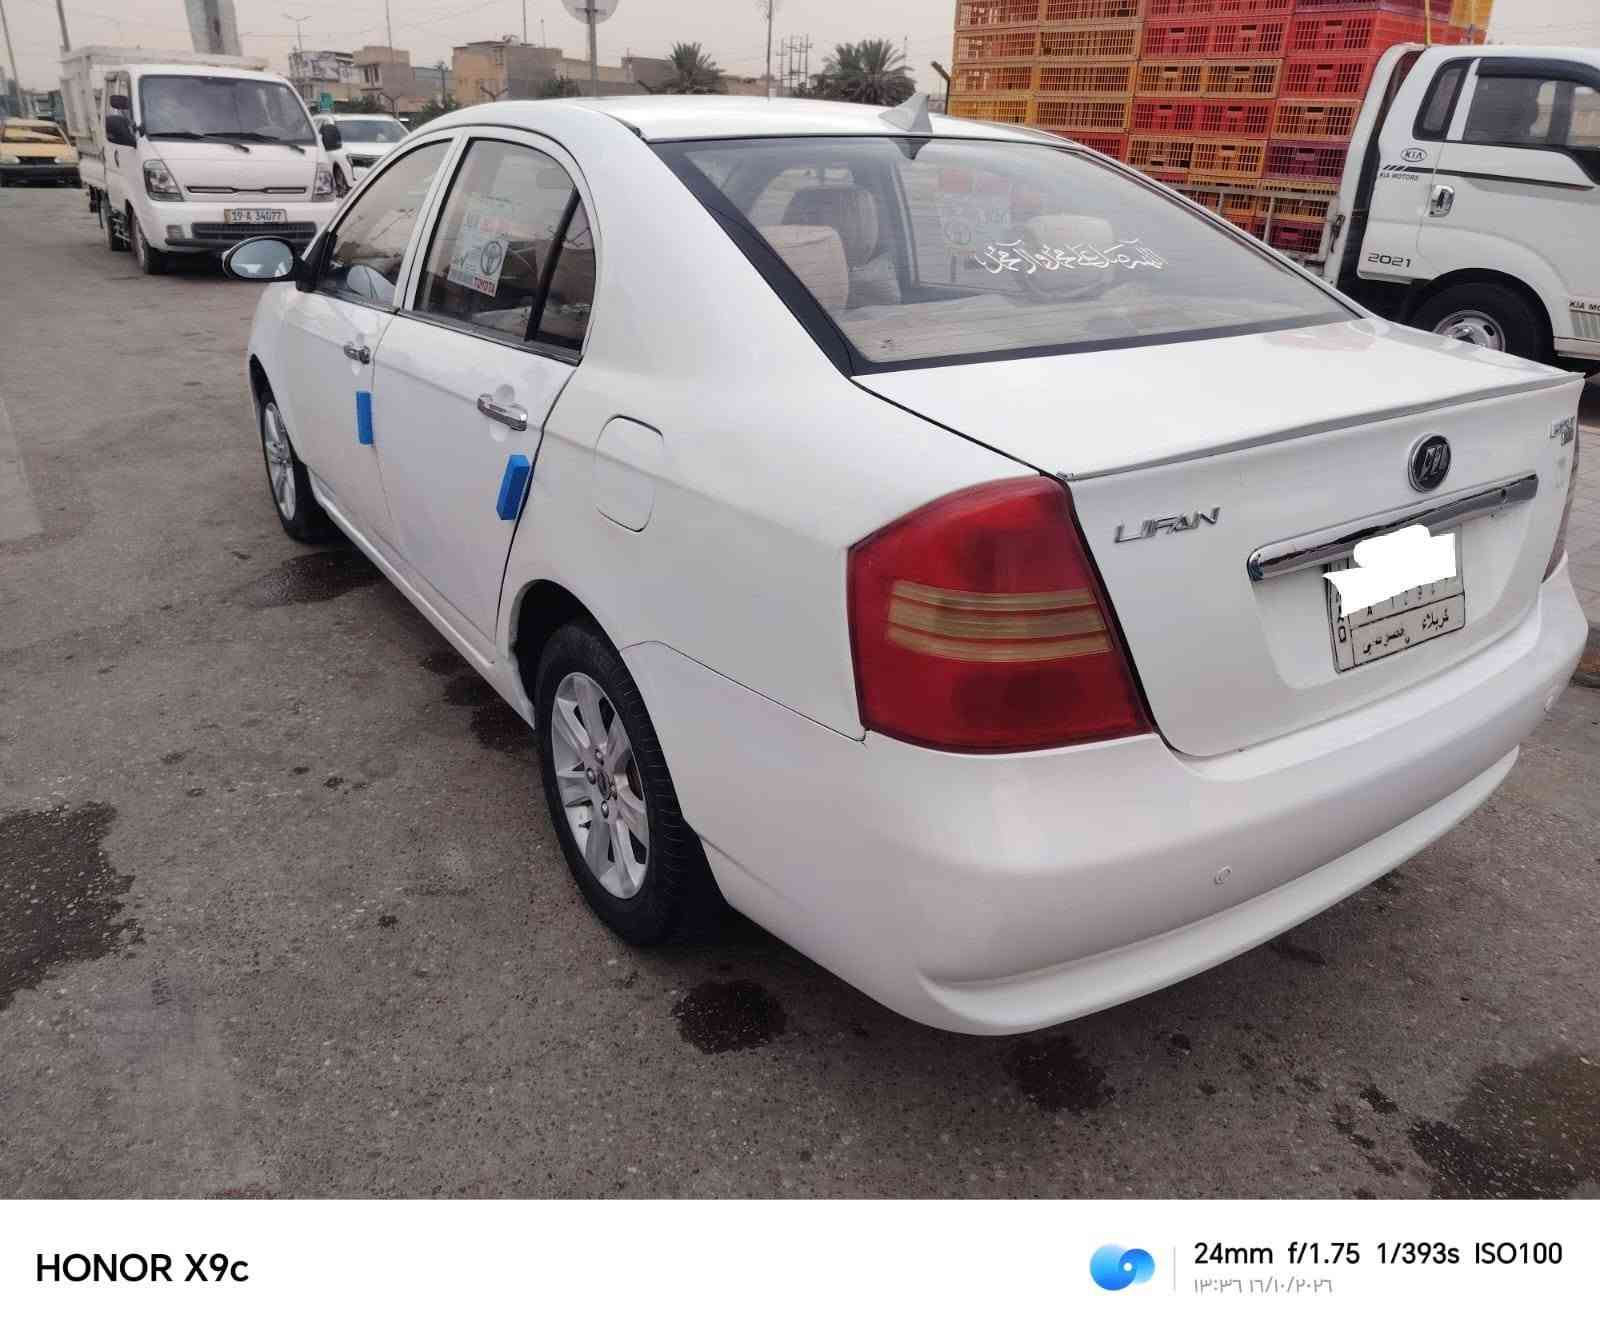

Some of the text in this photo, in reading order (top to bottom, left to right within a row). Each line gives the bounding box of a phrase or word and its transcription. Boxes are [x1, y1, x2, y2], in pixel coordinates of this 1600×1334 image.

[1403, 150, 1424, 160] KIA
[1367, 252, 1412, 268] 2021
[1569, 299, 1585, 310] KIA
[1114, 506, 1220, 544] LIFAN
